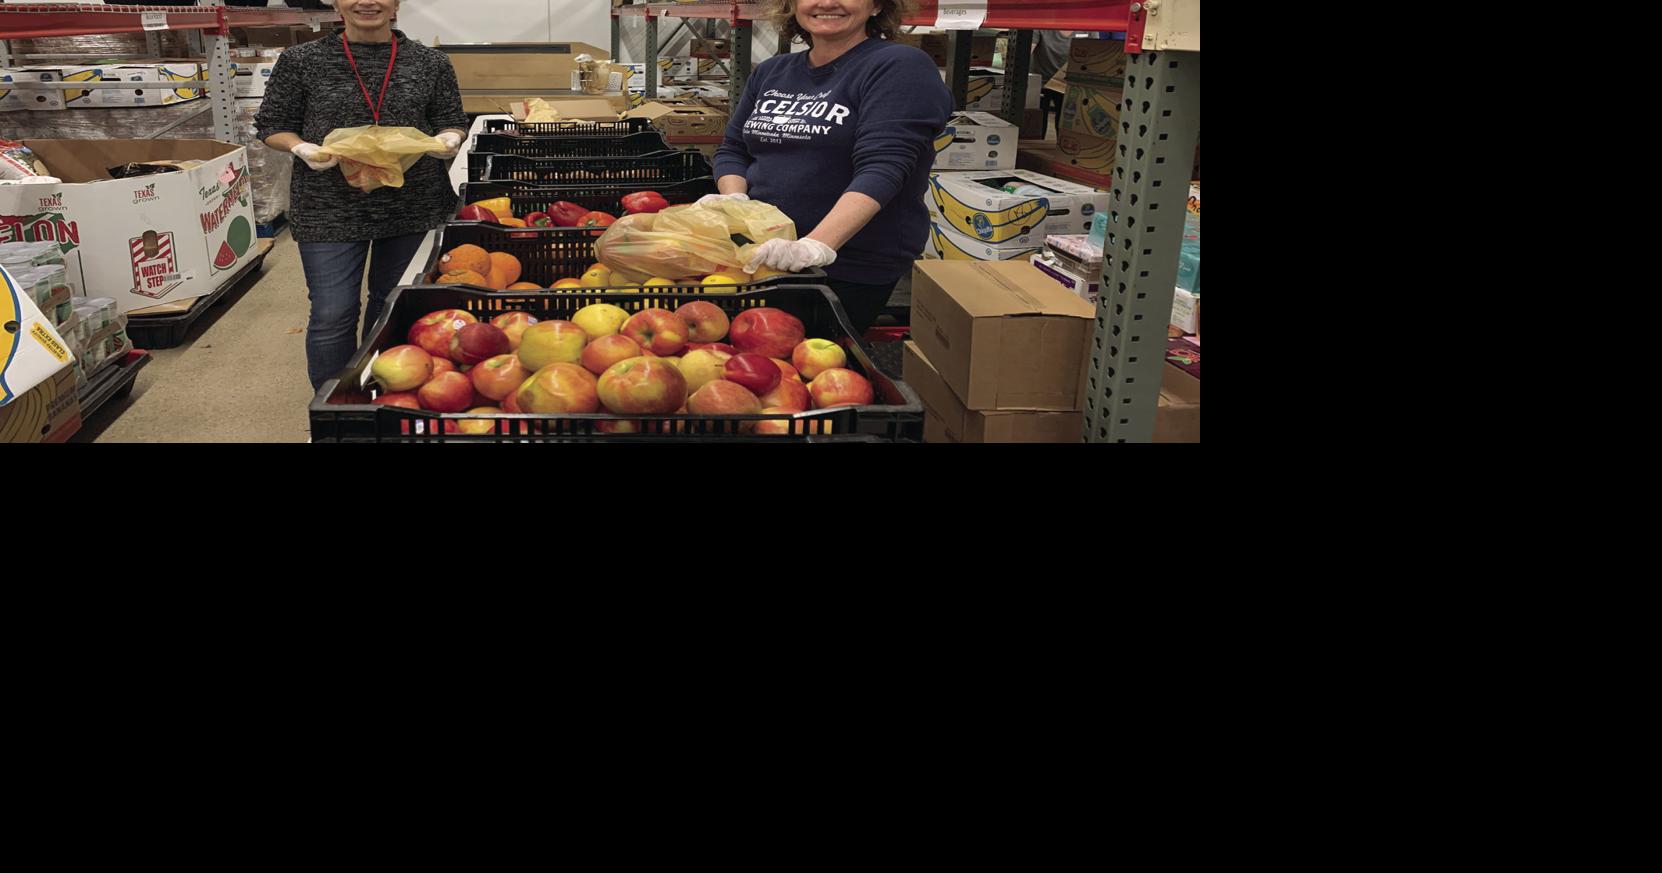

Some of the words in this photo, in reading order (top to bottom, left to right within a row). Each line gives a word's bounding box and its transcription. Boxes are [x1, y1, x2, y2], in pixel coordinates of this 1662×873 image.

[776, 125, 831, 135] COMPANY
[134, 188, 155, 199] TEXAS
[39, 198, 62, 207] TEXAS
[132, 195, 160, 204] grown
[141, 263, 167, 278] WATCH
[147, 275, 164, 289] STEP
